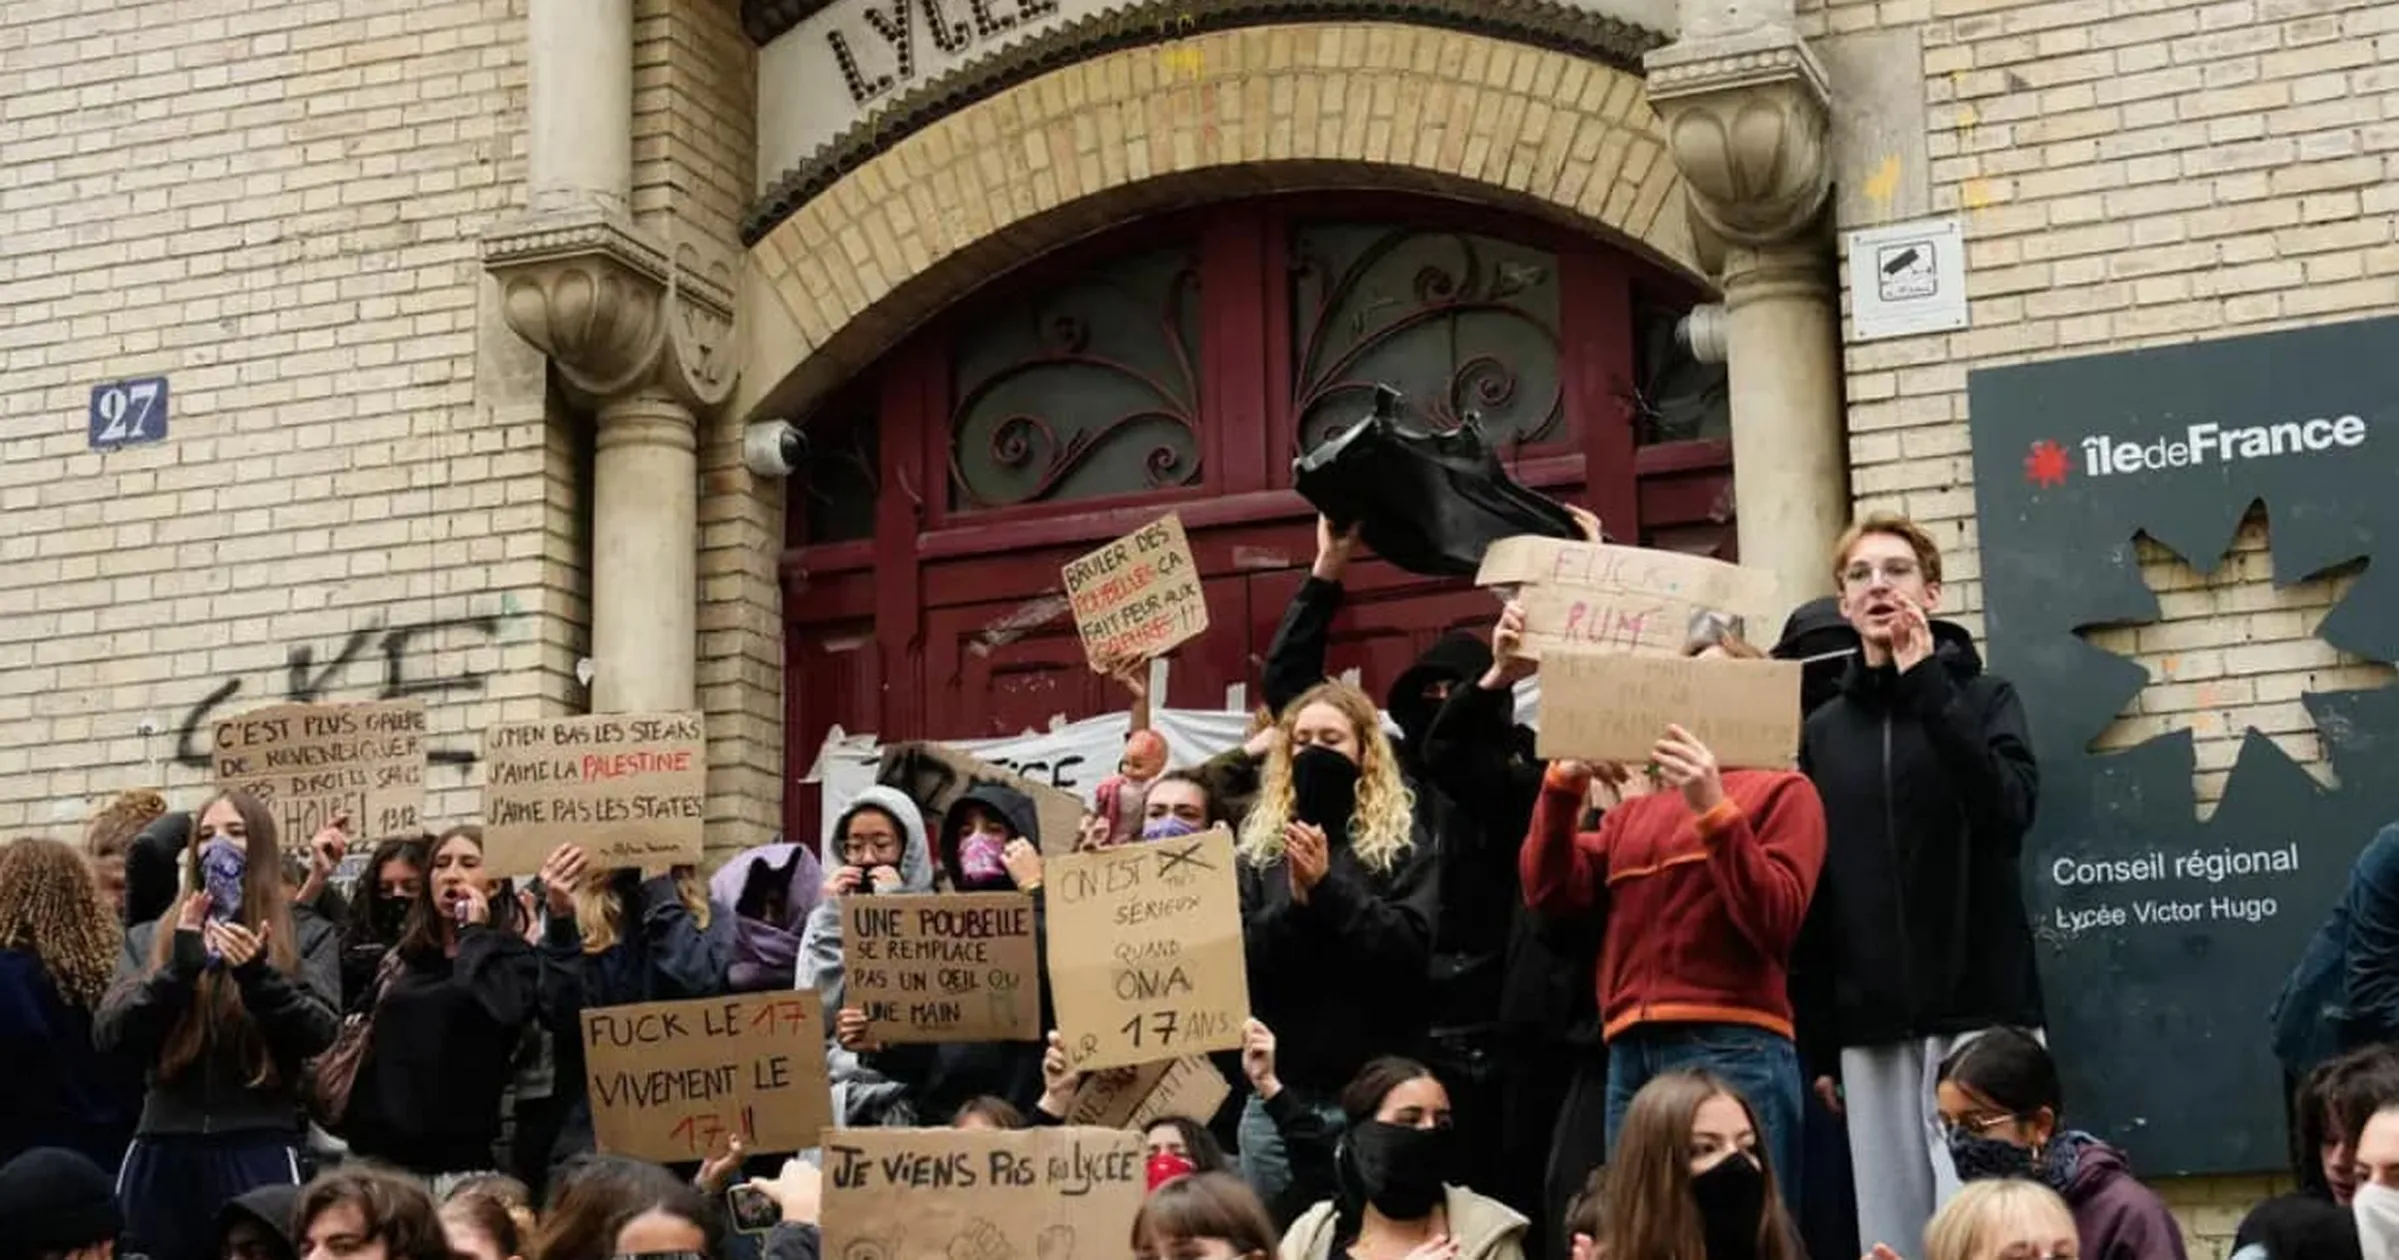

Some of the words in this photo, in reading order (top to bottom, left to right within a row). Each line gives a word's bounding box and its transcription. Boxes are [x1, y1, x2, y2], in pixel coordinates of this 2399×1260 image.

[826, 0, 1058, 107] LYC
[98, 382, 157, 441] 27
[1134, 522, 1171, 553] DES
[1081, 613, 1120, 647] FAIT
[1120, 595, 1163, 627] PEUR
[215, 717, 292, 750] C'EST
[303, 712, 358, 738] PLUS
[553, 723, 591, 746] BAS
[594, 721, 625, 743] LES
[629, 719, 701, 743] STEAKS
[291, 768, 368, 798] DROITS
[489, 760, 549, 785] J'AIME
[552, 760, 579, 781] LA
[581, 752, 693, 783] PALESTINE
[487, 796, 547, 827] J'AIME
[551, 799, 591, 824] PAS
[595, 797, 630, 821] LES
[630, 795, 703, 820] STATES
[1105, 854, 1148, 893] EST
[2052, 851, 2166, 885] Conseil
[2174, 842, 2299, 882] régional
[853, 907, 904, 938] UNE
[917, 906, 1030, 939] POUBELLE
[2055, 903, 2127, 931] Lycée
[2133, 900, 2203, 924] Victor
[2209, 896, 2278, 922] Hugo
[857, 940, 880, 960] SE
[886, 939, 989, 963] REMPLACE
[1114, 939, 1181, 965] QUAND
[853, 968, 888, 990] PAS
[899, 970, 928, 991] UN
[588, 1012, 690, 1047] FUCK
[703, 1002, 742, 1037] LE
[750, 999, 808, 1038] 17
[909, 1002, 962, 1025] MAIN
[1120, 1009, 1179, 1048] 17
[594, 1063, 739, 1109] VIVEMENT
[754, 1055, 791, 1090] LE
[669, 1113, 727, 1153] 17
[829, 1144, 872, 1188] JE
